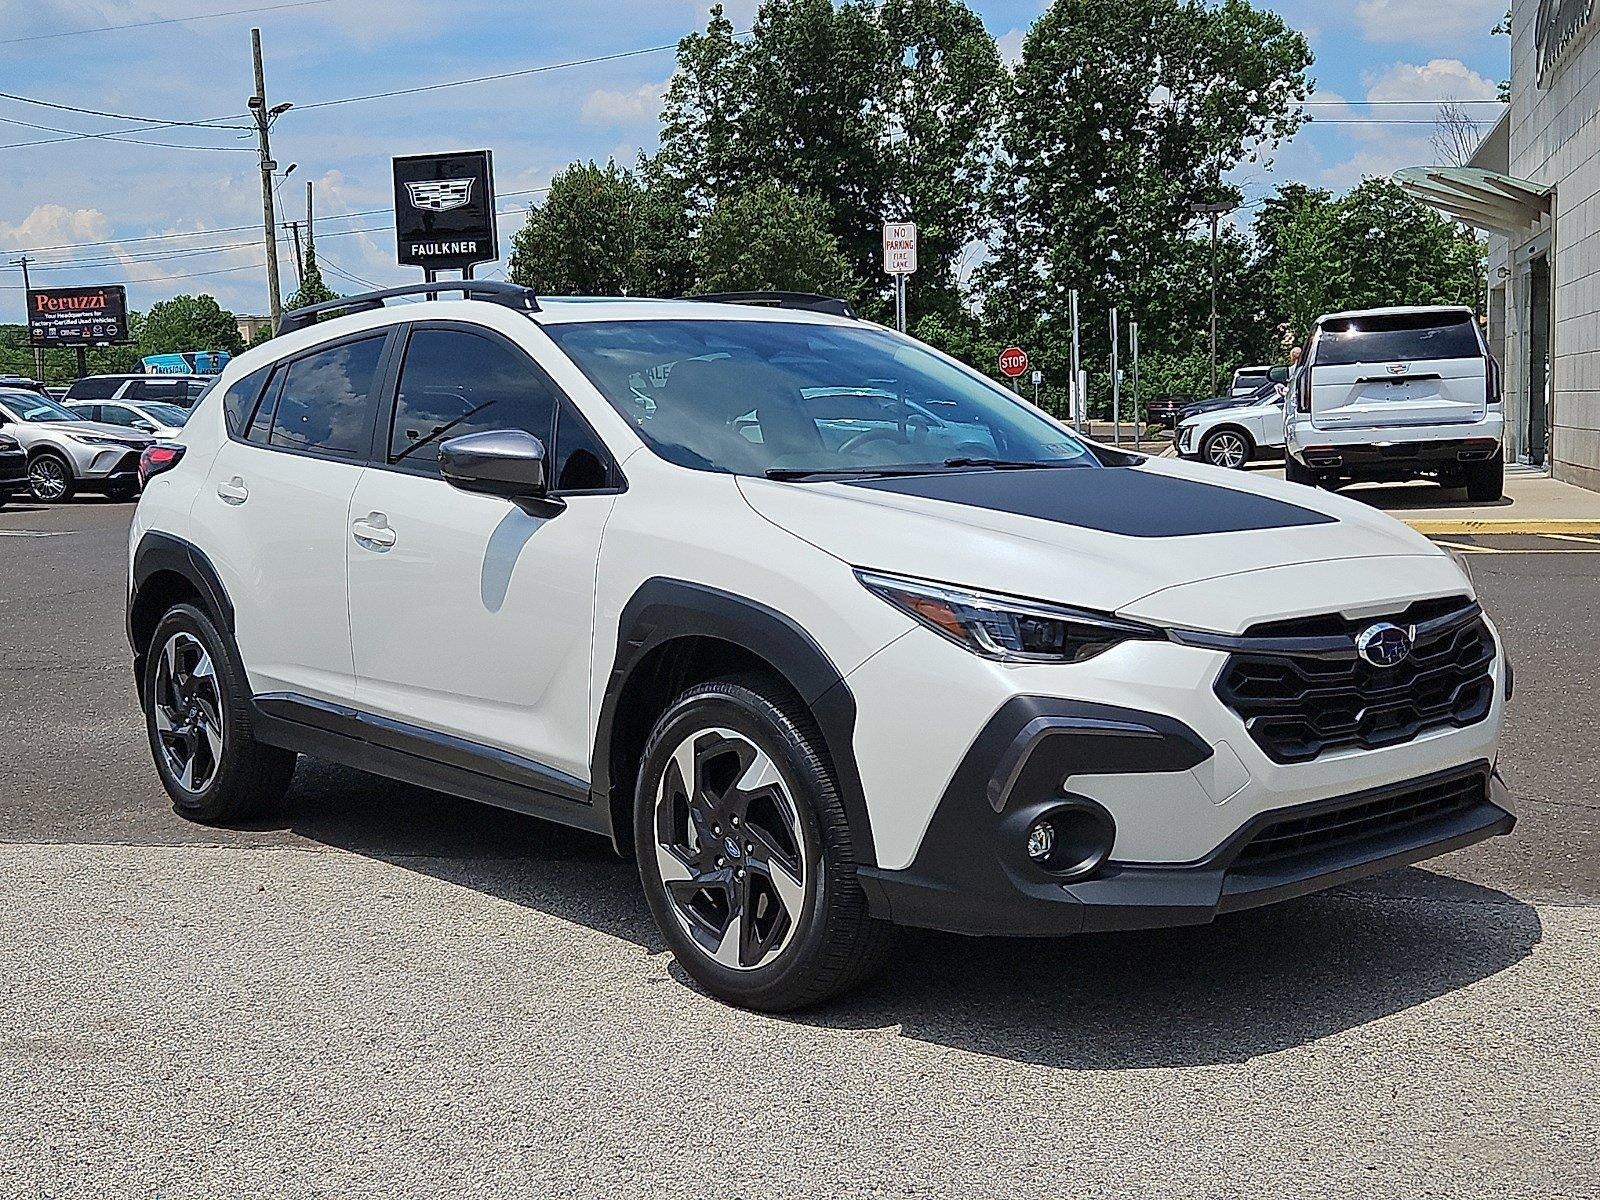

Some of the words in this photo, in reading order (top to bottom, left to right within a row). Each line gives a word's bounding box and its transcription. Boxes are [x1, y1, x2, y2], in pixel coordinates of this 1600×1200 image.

[894, 227, 906, 238] NO
[411, 242, 477, 256] FAULKNER
[886, 240, 914, 251] PARKING
[35, 290, 106, 311] Peruzzi
[1001, 355, 1025, 369] STOP
